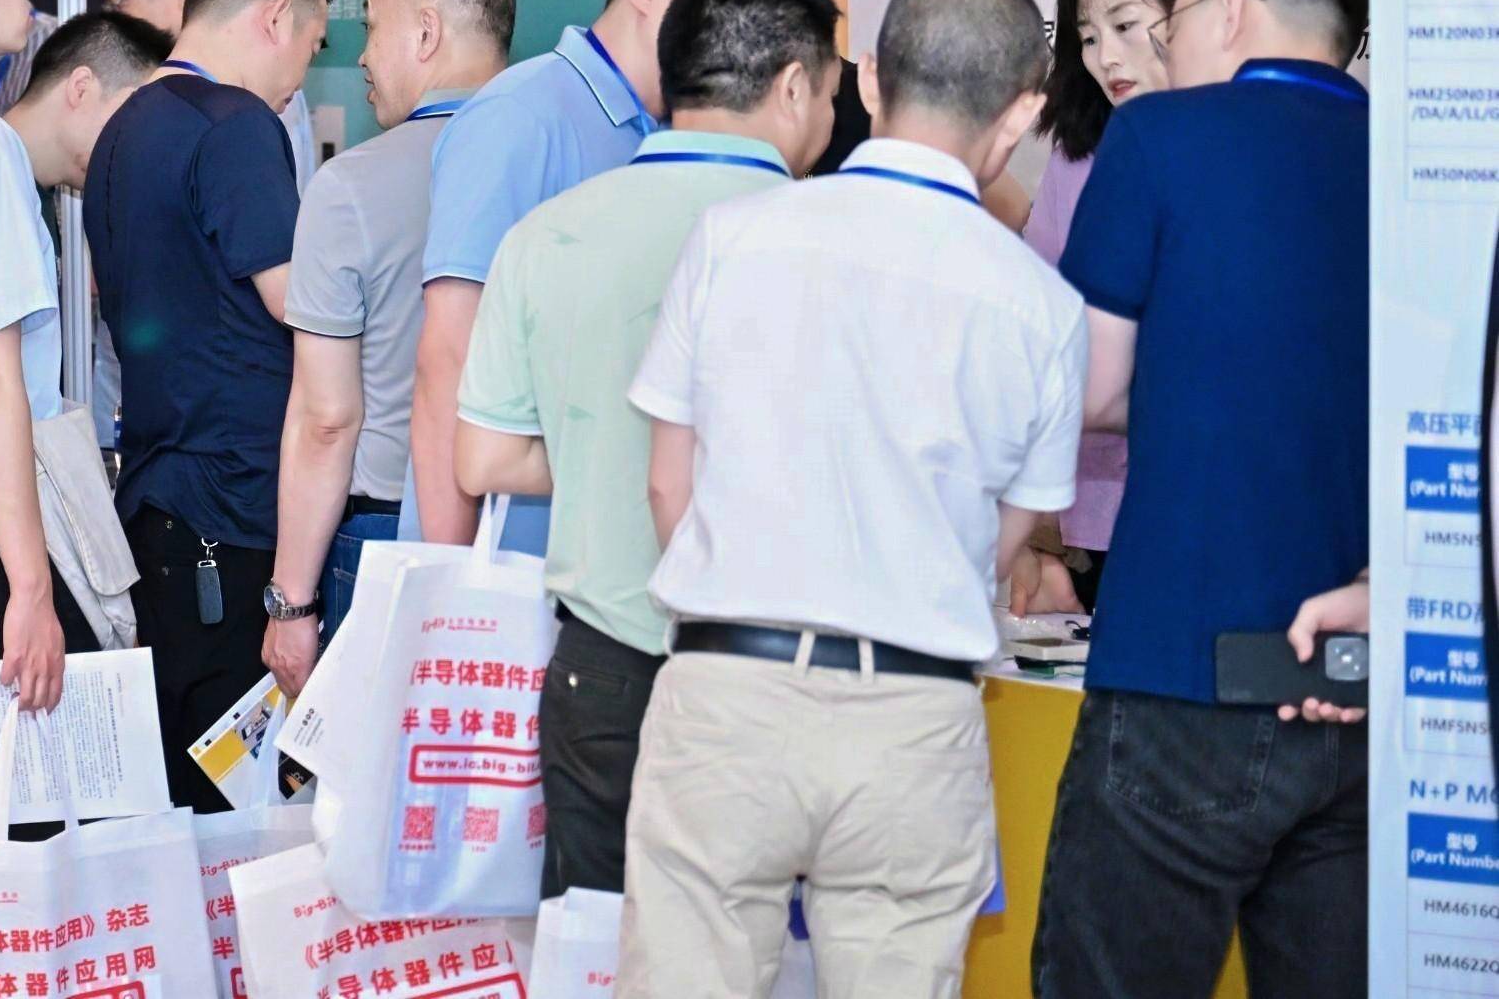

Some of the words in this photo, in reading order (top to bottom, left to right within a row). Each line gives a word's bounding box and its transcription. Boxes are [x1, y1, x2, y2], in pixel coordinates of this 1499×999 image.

[1409, 480, 1447, 498] (Part
[1409, 667, 1447, 684] (Part
[423, 757, 541, 774] www.ic.big-bit
[1410, 847, 1446, 865] (Part
[107, 903, 150, 933] 杂志
